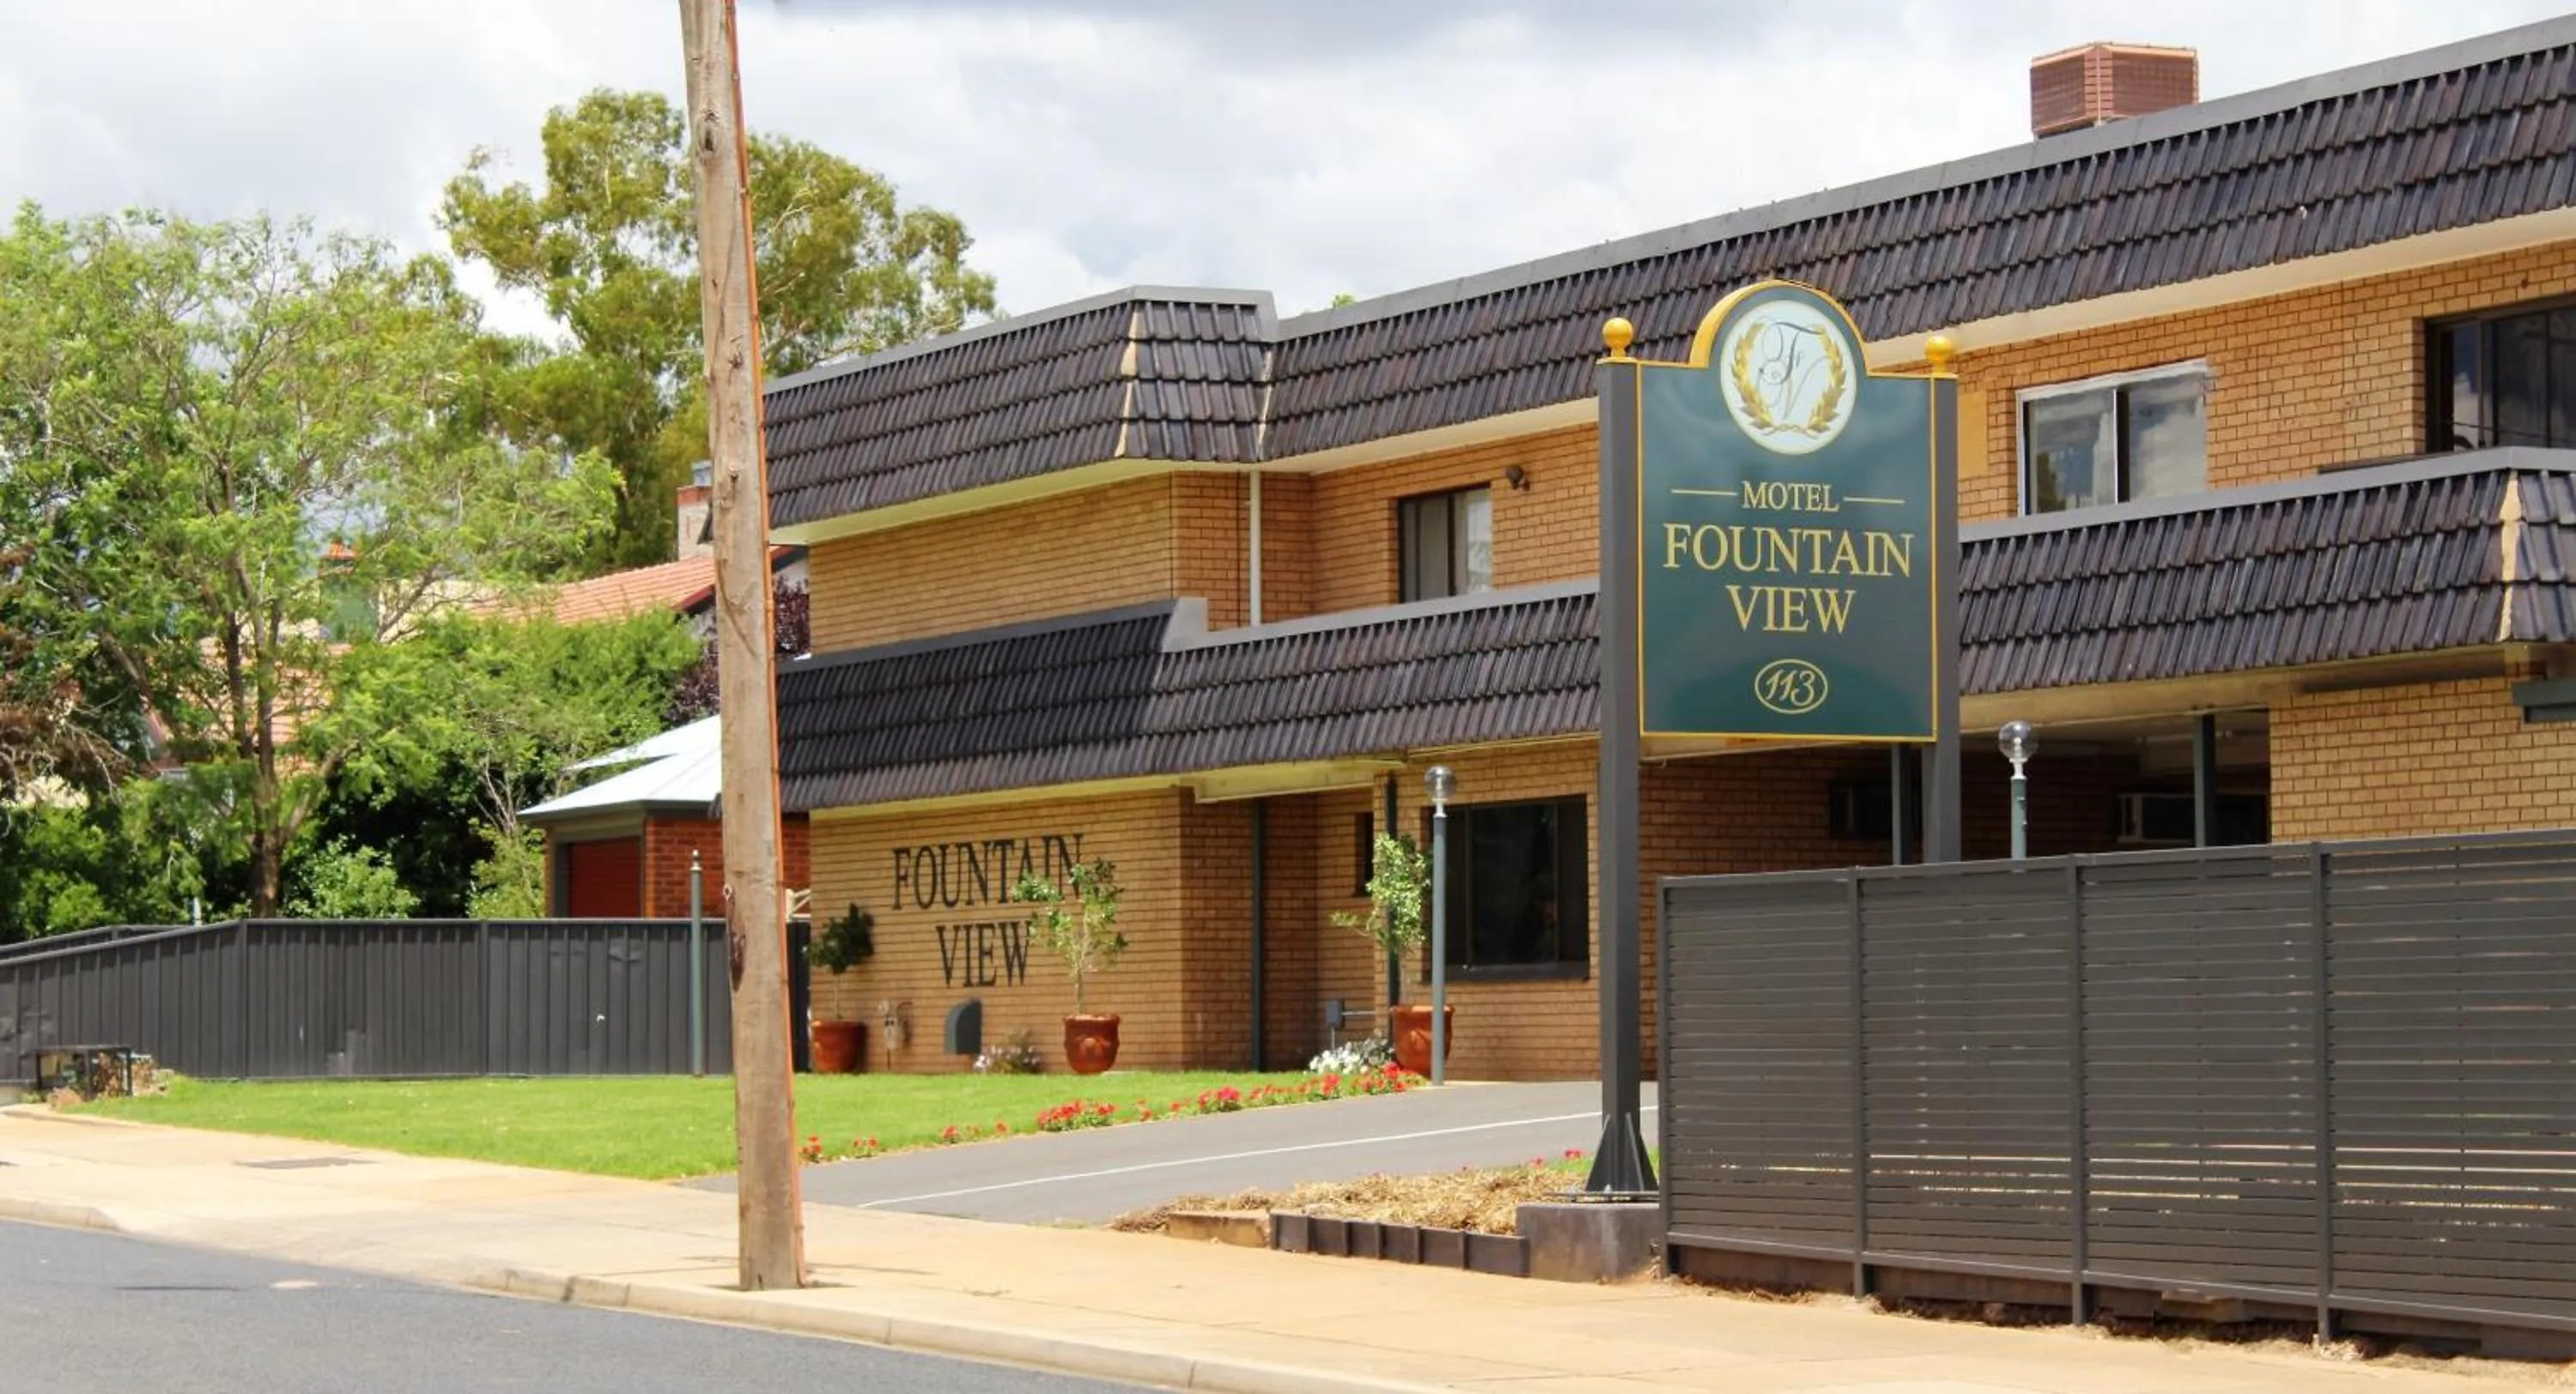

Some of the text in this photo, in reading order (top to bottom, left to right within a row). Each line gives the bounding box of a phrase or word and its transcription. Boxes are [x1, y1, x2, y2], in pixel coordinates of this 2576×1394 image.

[1741, 481, 1839, 512] MOTEL
[1662, 523, 1915, 578] FOUNTAIN
[1725, 585, 1856, 634] VIEW
[1765, 670, 1816, 706] 113
[892, 833, 1084, 910] FOUNTAIN
[936, 919, 1034, 989] VIEW
